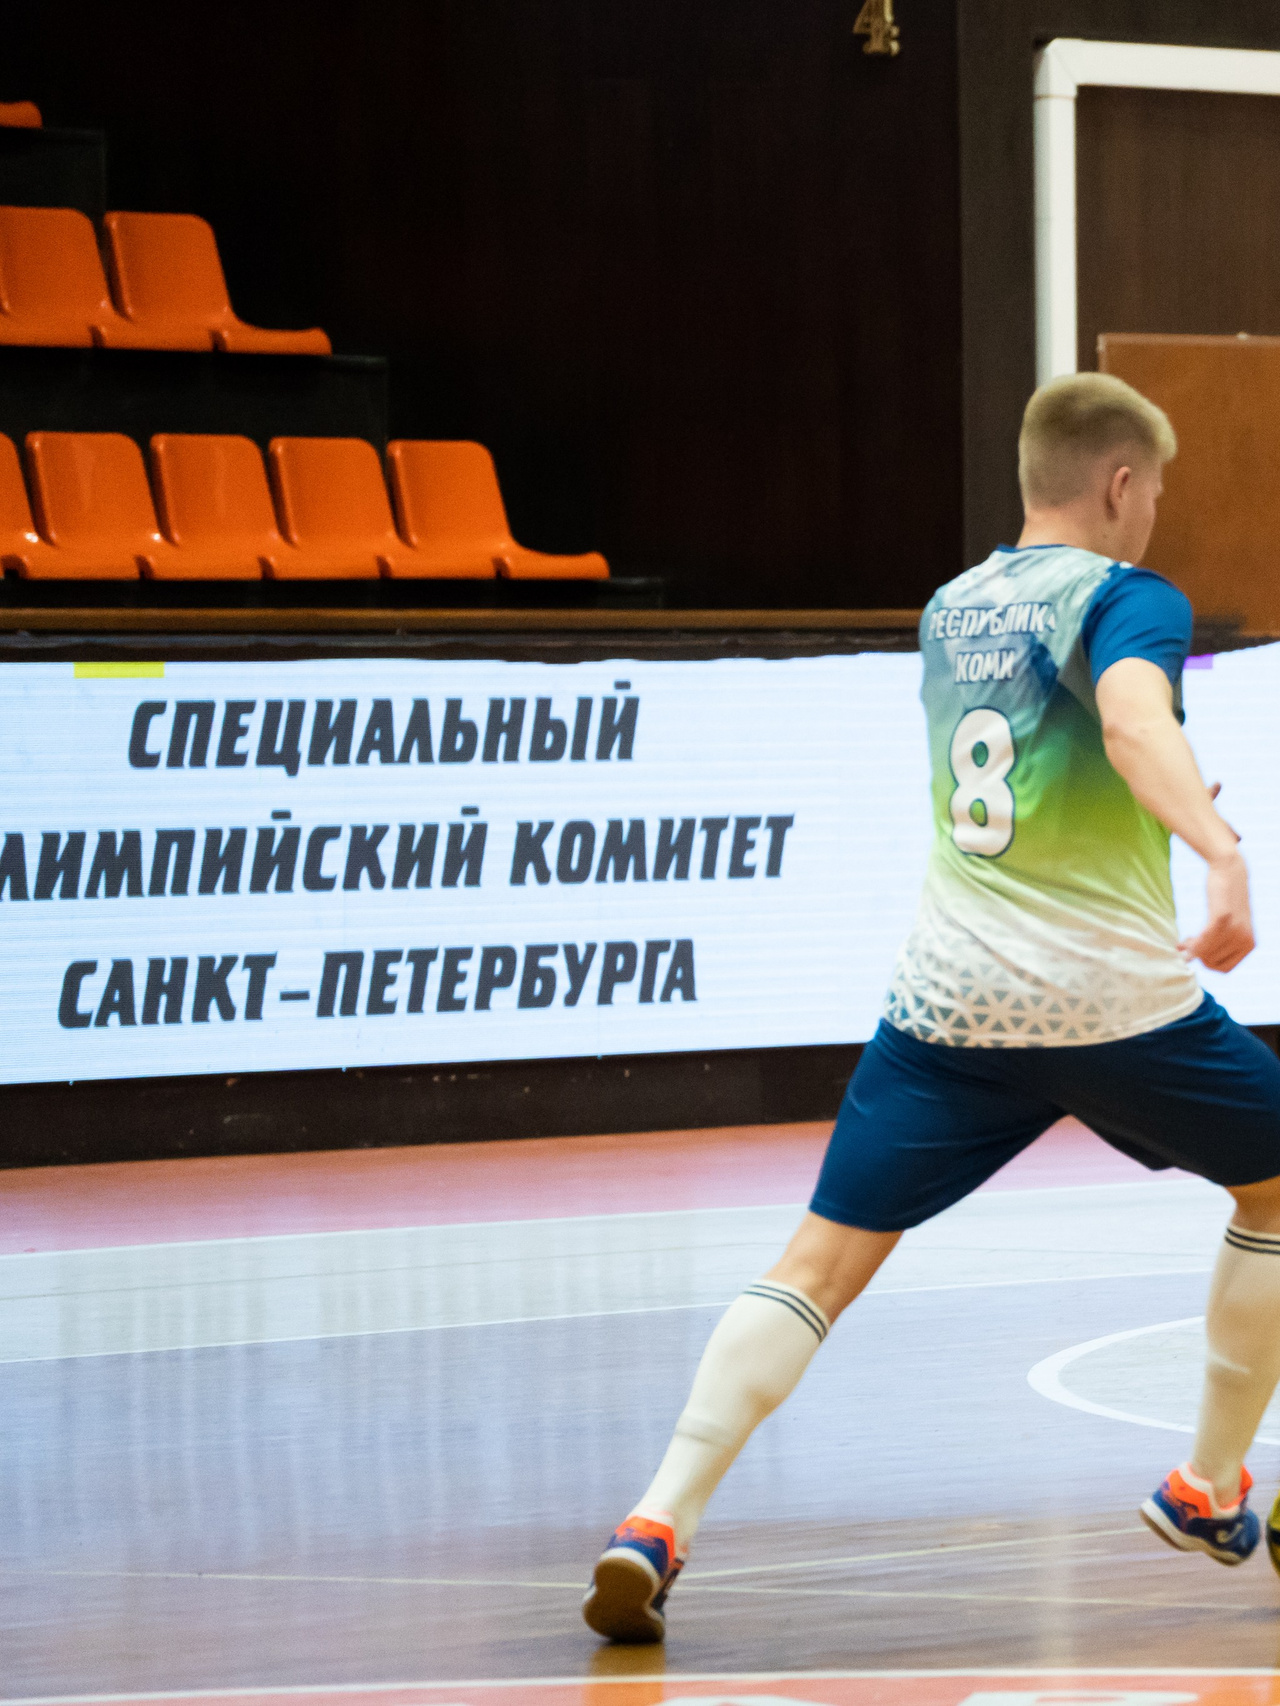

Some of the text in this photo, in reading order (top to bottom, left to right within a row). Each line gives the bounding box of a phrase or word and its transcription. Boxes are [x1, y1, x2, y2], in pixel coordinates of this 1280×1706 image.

[955, 650, 1016, 683] КОМИ
[128, 681, 640, 777] СПЕЦИАЛЬНЫЙ
[950, 706, 1015, 858] 8
[0, 807, 795, 902] ЛИМПИЙСКИЙ КОМИТЕТ
[57, 939, 697, 1029] САНКТ-ПЕТЕРБУРГА
